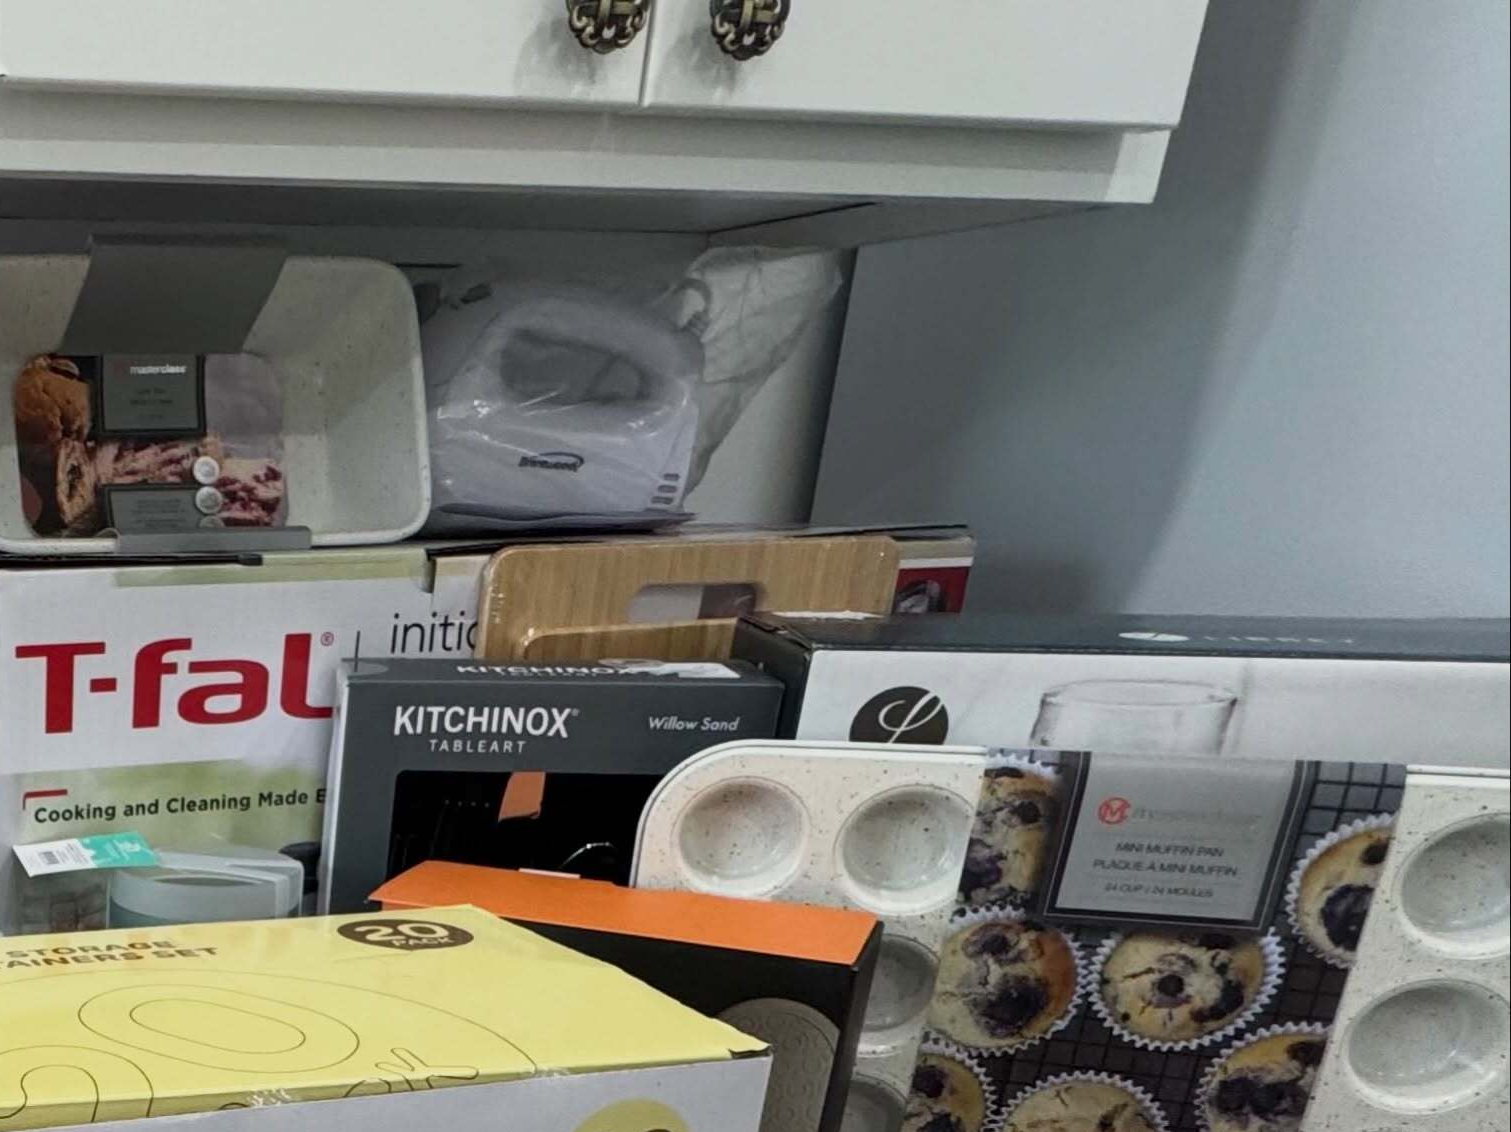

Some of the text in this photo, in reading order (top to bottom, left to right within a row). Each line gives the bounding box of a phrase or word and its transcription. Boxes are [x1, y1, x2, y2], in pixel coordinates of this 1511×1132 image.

[15, 633, 333, 734] T-fal
[393, 705, 572, 739] KITCHINOX
[649, 716, 740, 731] Willow Sand
[429, 739, 526, 755] TABLEART
[34, 803, 116, 824] Cooking
[123, 799, 159, 817] and
[166, 793, 251, 814] Cleaning
[257, 789, 308, 807] Made
[354, 923, 450, 941] 20
[6, 940, 177, 957] STORAGE
[154, 947, 219, 960] SET
